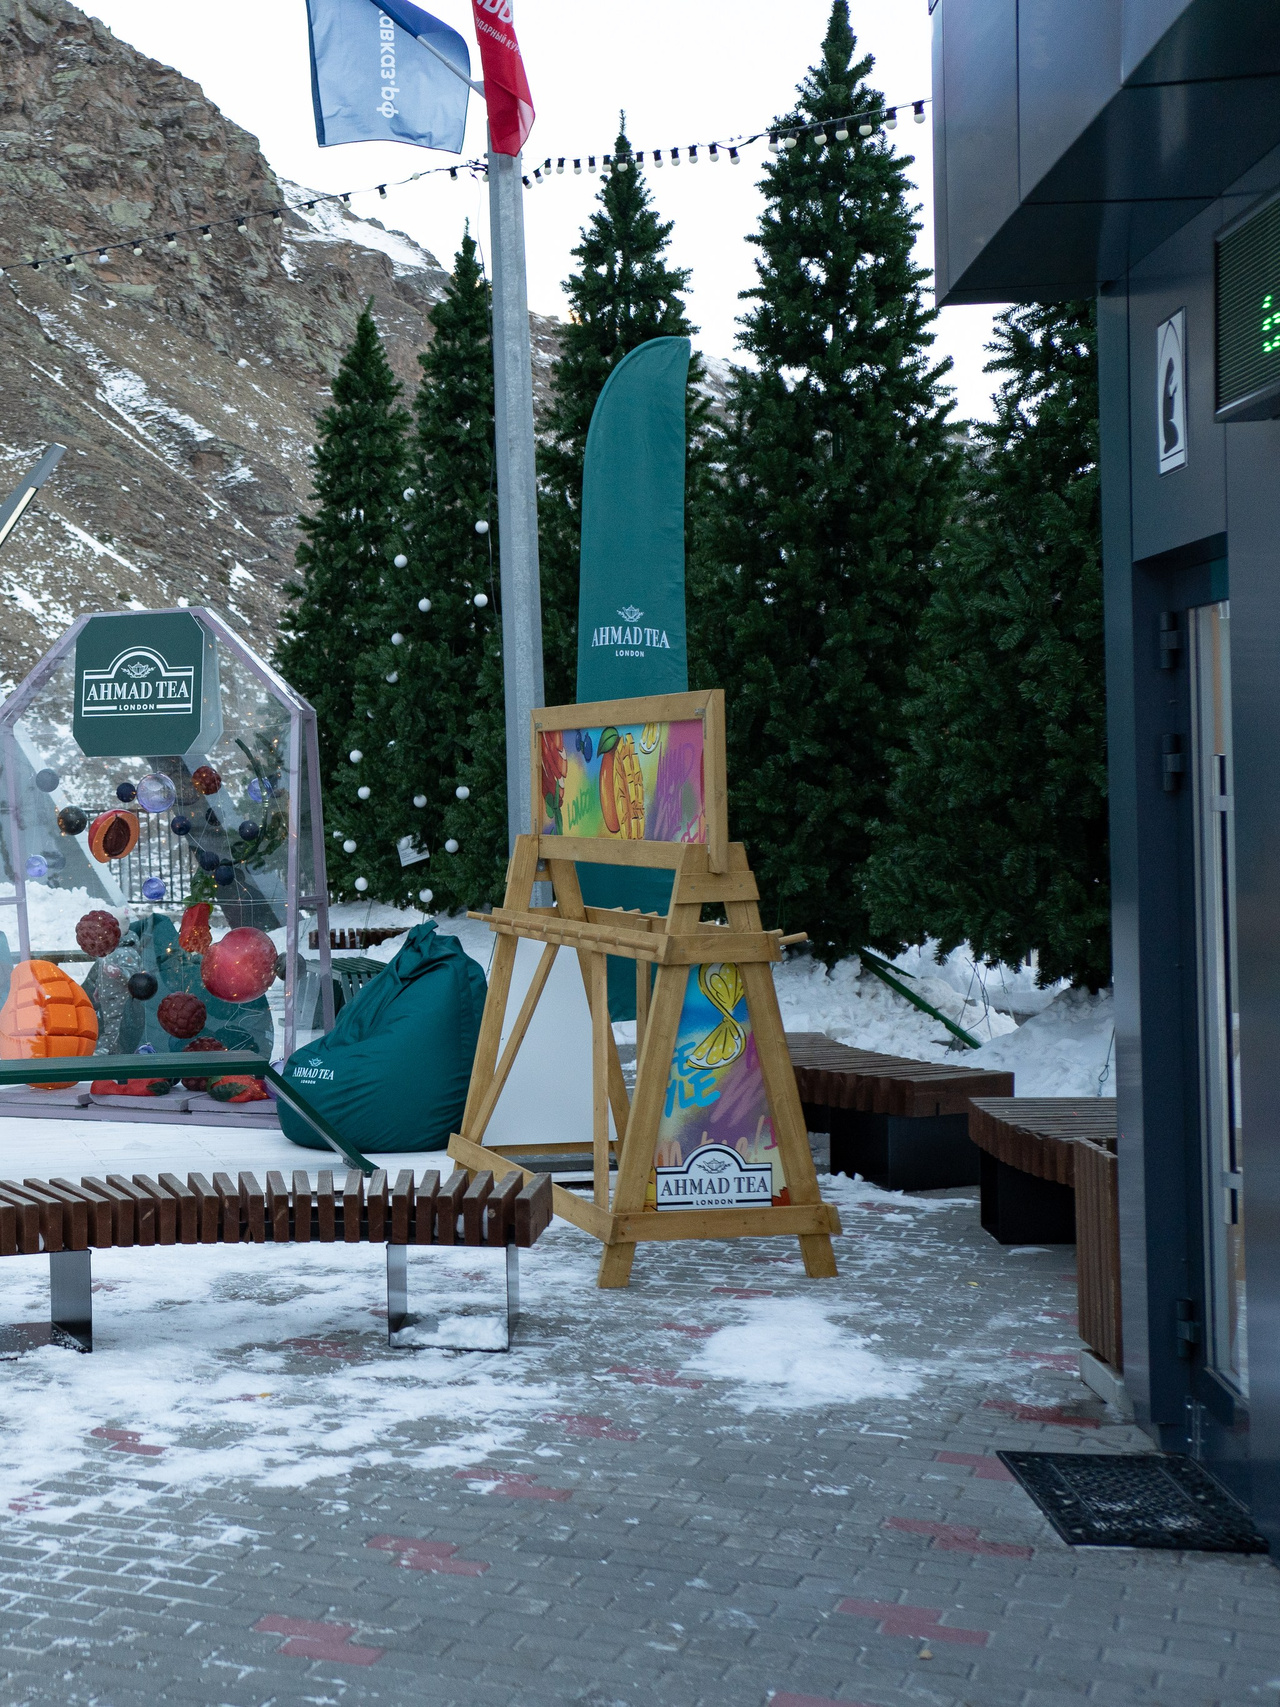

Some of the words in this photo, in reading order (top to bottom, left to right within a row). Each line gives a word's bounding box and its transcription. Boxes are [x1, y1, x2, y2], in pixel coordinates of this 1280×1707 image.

[591, 626, 643, 648] AHMAD
[644, 628, 671, 649] TEA
[86, 682, 153, 701] AHMAD
[155, 680, 190, 699] TEA
[119, 703, 155, 711] LONDON
[292, 1066, 318, 1078] AHMAD
[318, 1068, 334, 1080] TEA
[660, 1177, 731, 1197] AHMAD
[733, 1175, 770, 1194] TEA
[695, 1198, 734, 1206] LONDON
